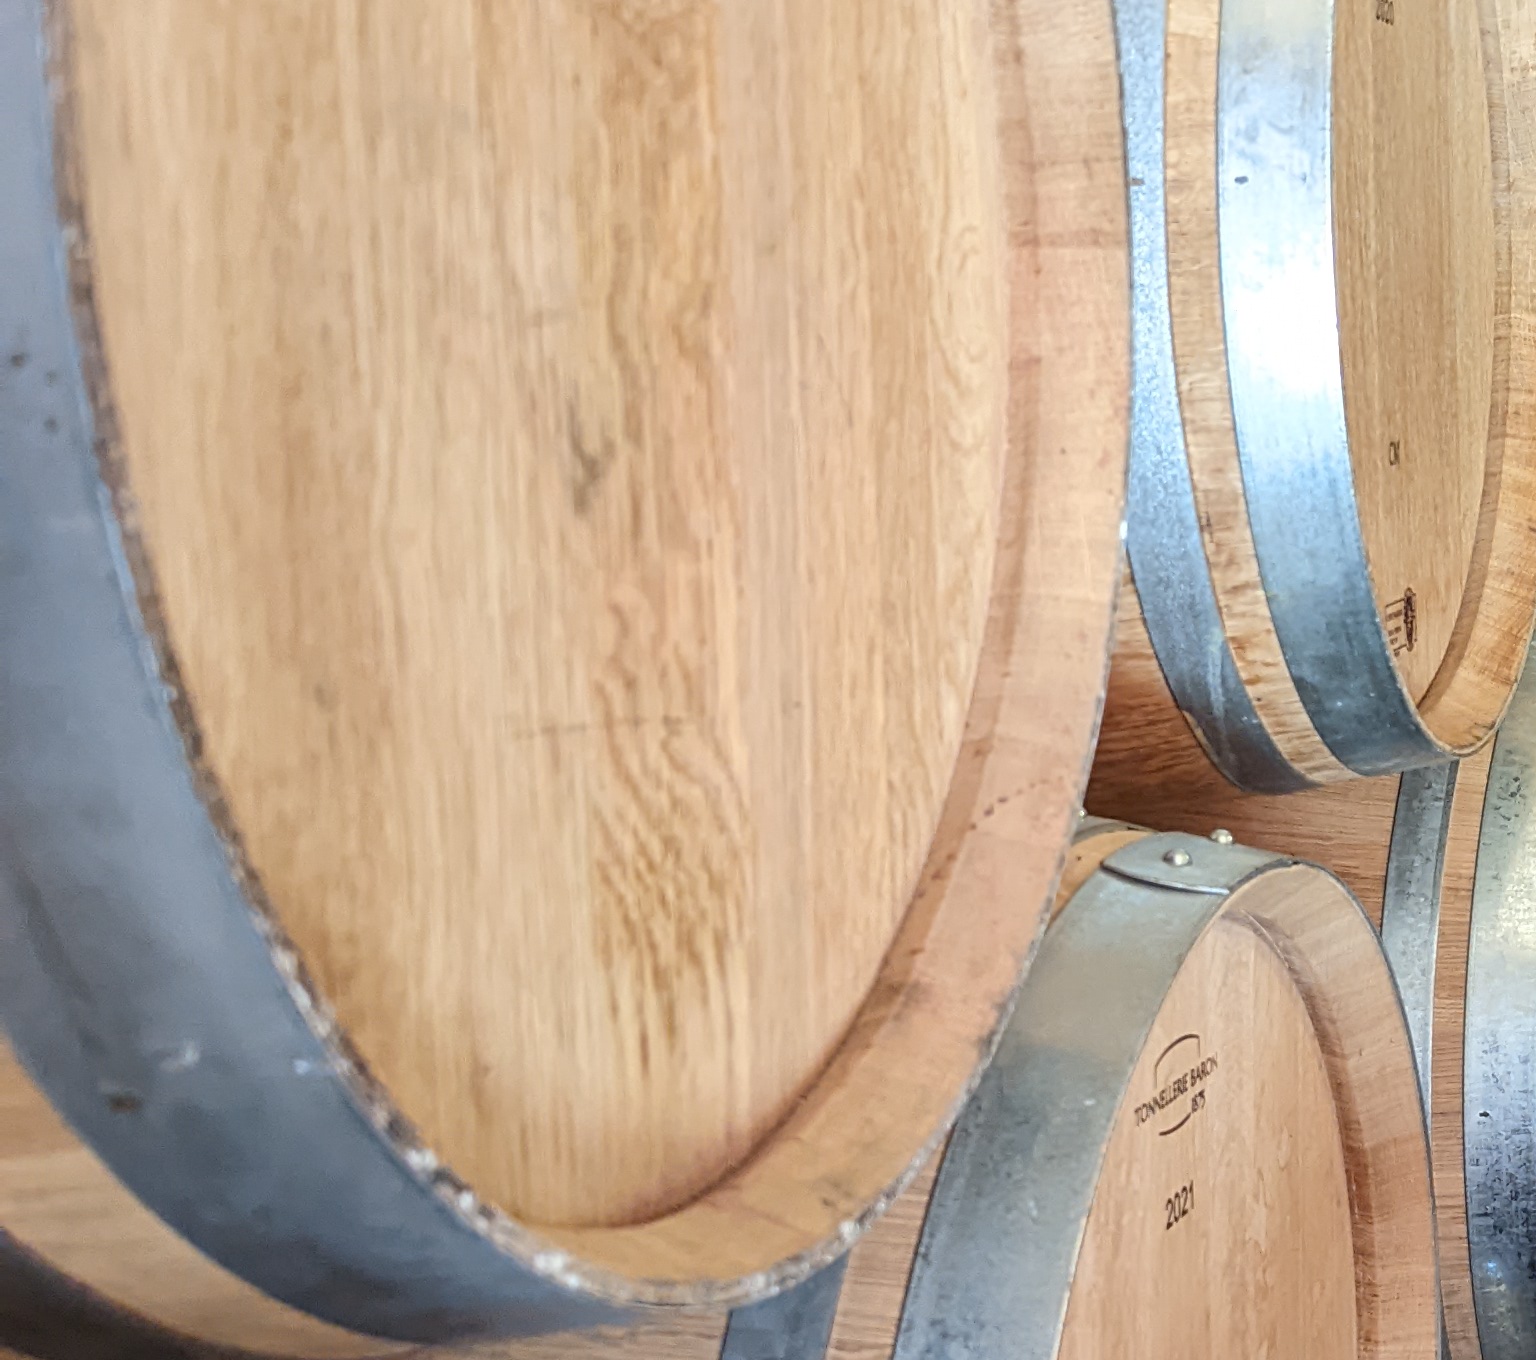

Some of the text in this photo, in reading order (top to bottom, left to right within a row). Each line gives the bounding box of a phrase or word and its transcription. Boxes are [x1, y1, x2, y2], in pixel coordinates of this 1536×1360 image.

[1134, 1052, 1218, 1127] TONNELLERIE BARON
[1165, 1180, 1195, 1231] 2021
